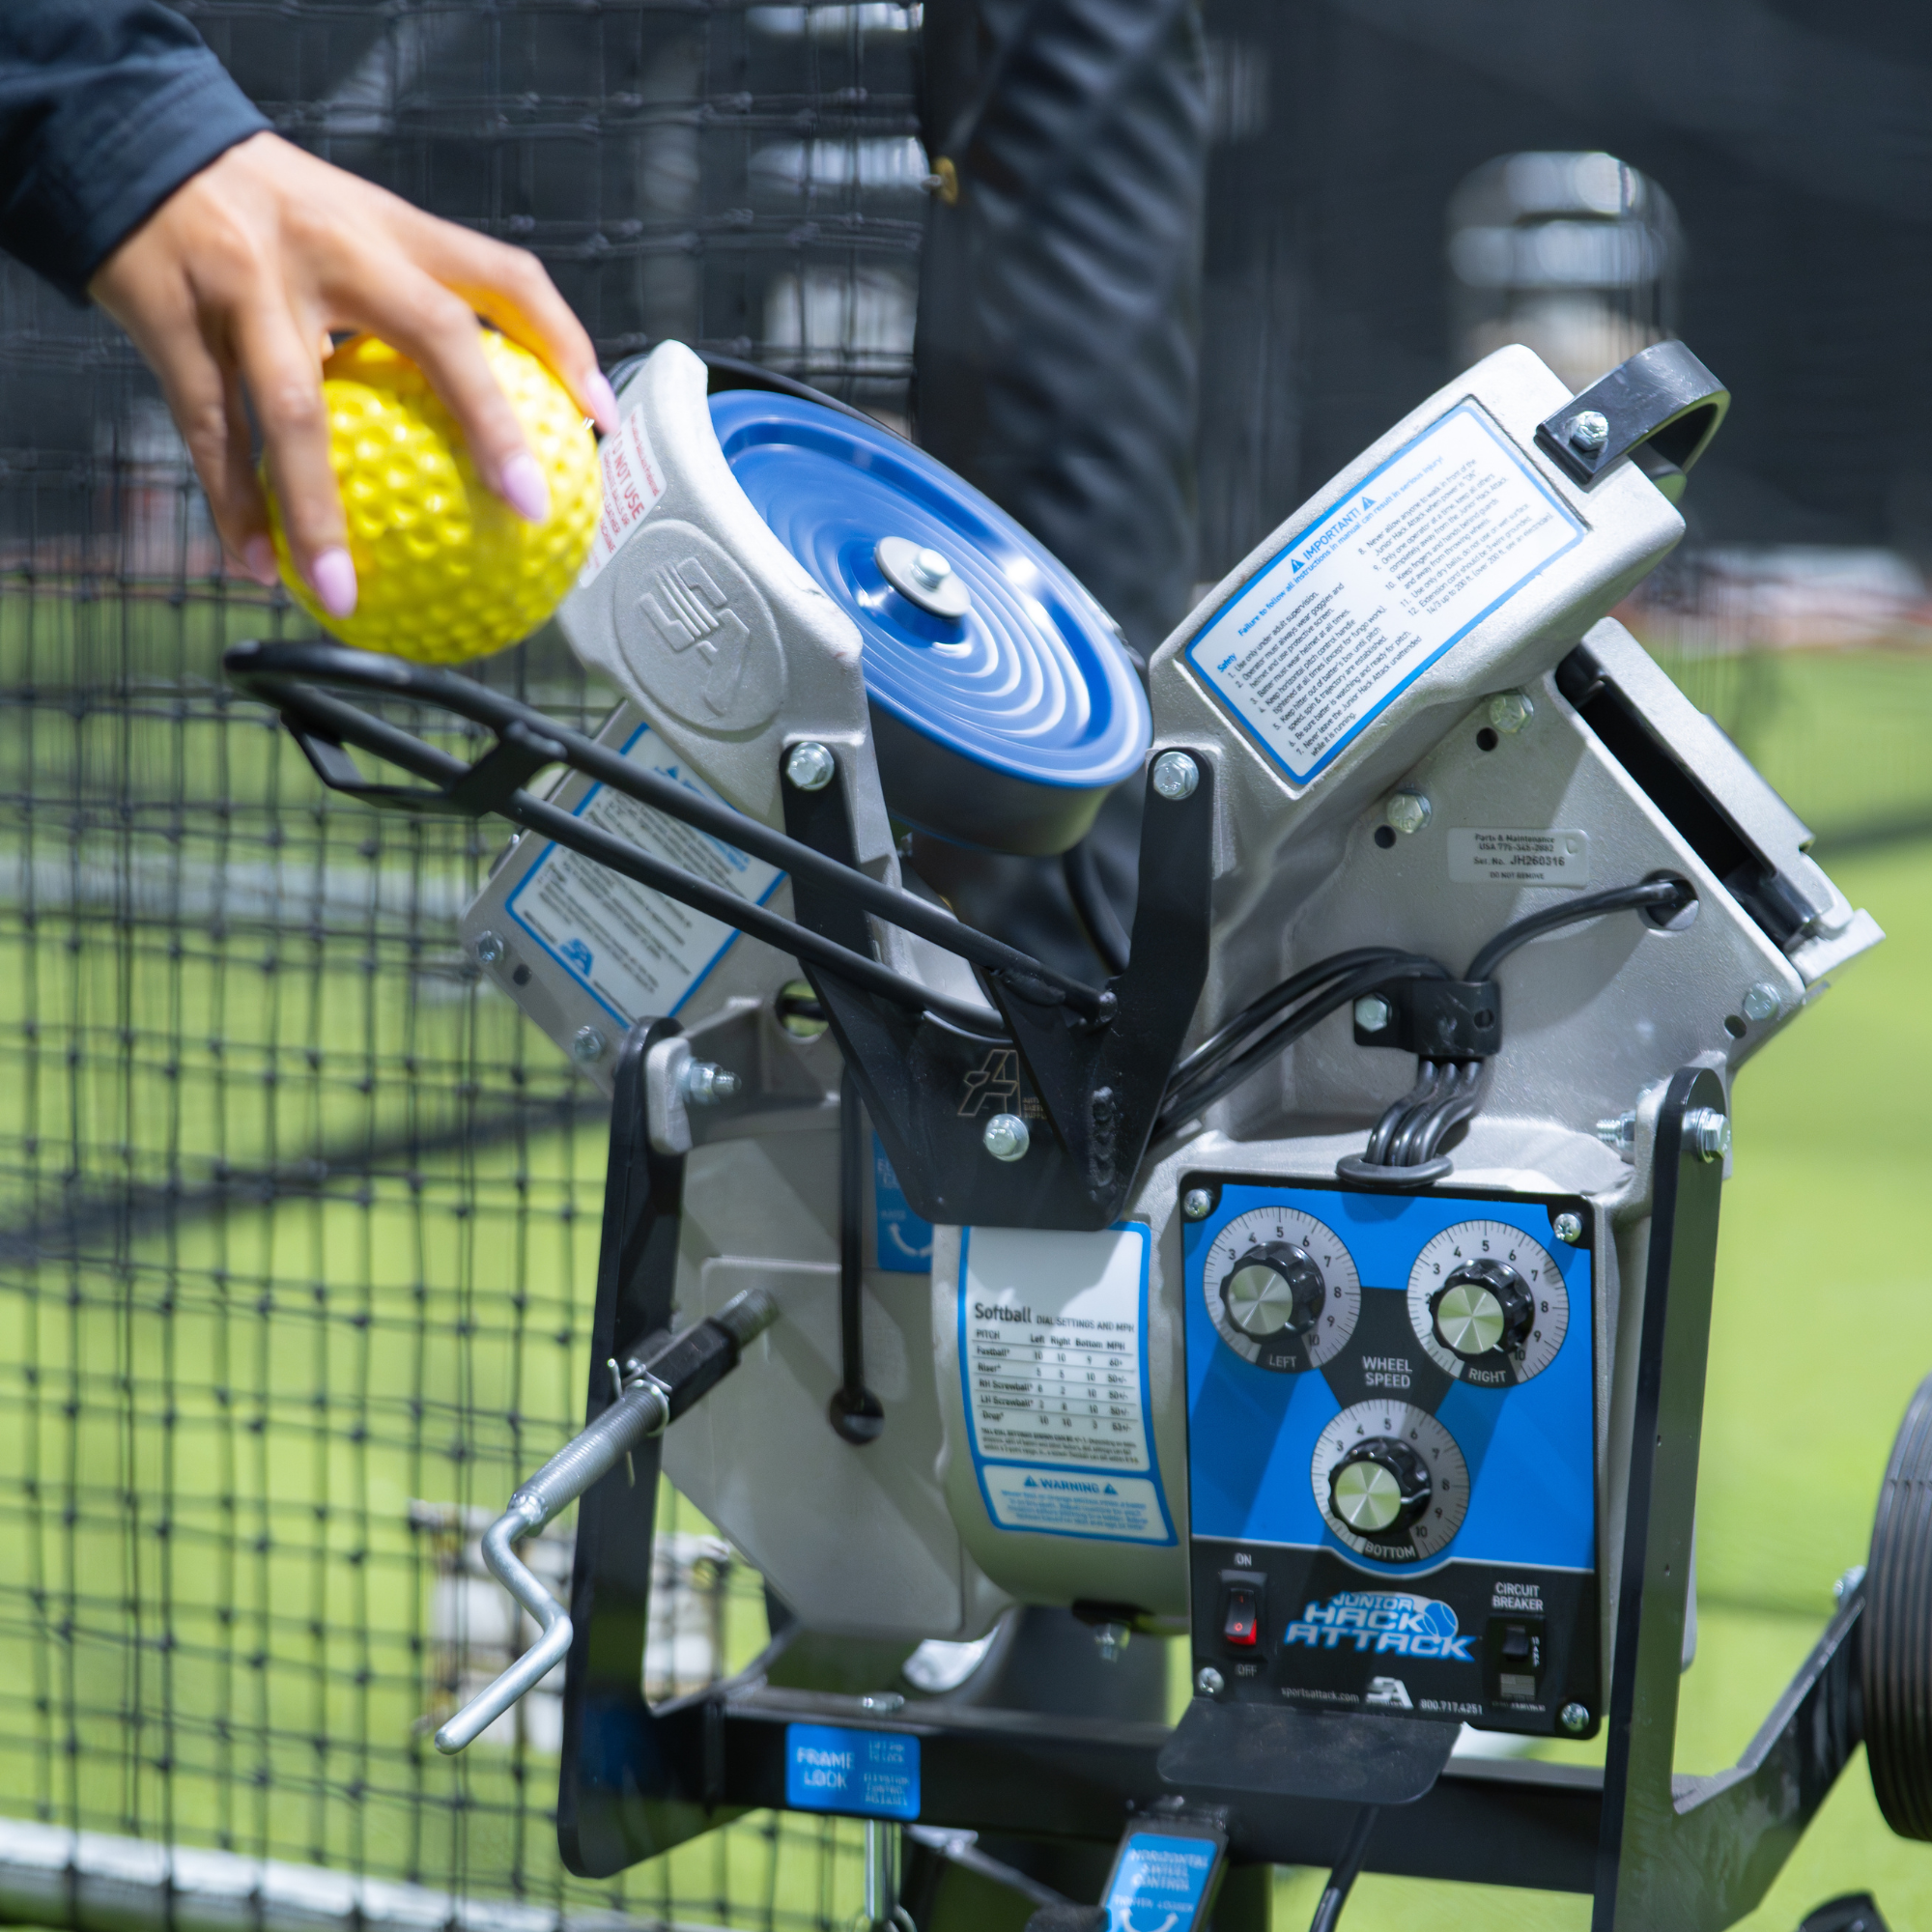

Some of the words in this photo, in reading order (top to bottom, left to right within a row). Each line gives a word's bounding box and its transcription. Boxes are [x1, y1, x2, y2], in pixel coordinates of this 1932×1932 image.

[614, 456, 632, 485] NOT
[624, 483, 645, 520] USE
[1303, 508, 1358, 560] IMPORTANT!
[1238, 615, 1259, 636] Failure
[1265, 591, 1286, 609] follow
[1286, 582, 1294, 591] all
[1293, 551, 1330, 583] instructions
[1338, 522, 1361, 544] manual
[1362, 513, 1374, 524] can
[1374, 497, 1393, 513] result
[1400, 473, 1422, 492] serious
[1422, 456, 1443, 473] injury!
[1235, 661, 1246, 671] Use
[1245, 649, 1258, 662] only
[1257, 634, 1271, 650] under
[1272, 620, 1287, 636] adult
[1286, 592, 1319, 622] supervision.
[1242, 657, 1264, 681] Operator
[1264, 644, 1279, 659] must
[1278, 627, 1297, 646] always
[1296, 613, 1310, 628] wear
[1311, 594, 1333, 616] goggles
[1332, 582, 1344, 595] and
[1249, 669, 1268, 689] helmet
[1267, 659, 1279, 671] and
[1278, 651, 1288, 661] use
[1287, 626, 1314, 653] protective
[1314, 609, 1333, 627] screen.
[1257, 680, 1273, 697] Batter
[1273, 667, 1288, 682] must
[1287, 654, 1300, 668] wear
[1299, 637, 1320, 656] helmet
[1332, 610, 1350, 625] times.
[1217, 655, 1236, 672] Safety
[1264, 692, 1280, 706] Keep
[1278, 667, 1304, 694] horizontal
[1304, 655, 1319, 669] pitch
[1317, 637, 1337, 656] control
[1335, 620, 1355, 638] handle
[1272, 689, 1297, 714] tightened
[1309, 663, 1324, 678] times
[1322, 644, 1345, 665] (except
[1343, 636, 1351, 645] for
[1350, 622, 1369, 638] fungo
[1280, 709, 1294, 724] Keep
[1293, 695, 1308, 710] hitter
[1308, 686, 1318, 696] out
[1321, 662, 1344, 682] batter's
[1342, 653, 1353, 663] box
[1353, 639, 1367, 652] until
[1366, 627, 1380, 642] pitch
[1507, 835, 1555, 843] Maintenance
[1511, 856, 1565, 866] JH260316
[1277, 1227, 1283, 1237] 5
[1303, 1236, 1310, 1247] 6
[1482, 1240, 1490, 1252] 5
[1229, 1249, 1236, 1260] 3
[1454, 1246, 1461, 1258] 4
[1509, 1250, 1517, 1261] 6
[1324, 1256, 1331, 1267] 7
[1434, 1264, 1440, 1274] 3
[1531, 1269, 1538, 1281] 7
[1334, 1287, 1341, 1298] 8
[1542, 1301, 1548, 1312] 8
[976, 1302, 1032, 1323] Softball
[1037, 1316, 1053, 1325] DIAL
[1057, 1318, 1094, 1329] SETTINGS
[1097, 1321, 1114, 1331] AND
[1117, 1322, 1134, 1332] MPH
[1327, 1316, 1335, 1327] 9
[977, 1329, 1000, 1340] PITCH
[1031, 1334, 1045, 1345] Left
[1051, 1335, 1070, 1347] Right
[1076, 1338, 1103, 1349] Bottom
[1107, 1341, 1125, 1350] MPH
[1309, 1335, 1320, 1346] 10
[1534, 1331, 1541, 1342] 9
[1269, 1354, 1296, 1368] LEFT
[1515, 1350, 1525, 1360] 10
[1362, 1356, 1412, 1373] WHEEL
[1366, 1373, 1410, 1387] SPEED
[1469, 1368, 1506, 1383] RIGHT
[1356, 1424, 1364, 1435] 4
[1385, 1418, 1392, 1430] 5
[1410, 1428, 1418, 1439] 6
[1039, 1478, 1099, 1493] WARNING
[1416, 1525, 1428, 1537] 10
[1364, 1540, 1416, 1557] BOTTOM
[1235, 1553, 1252, 1566] ON
[1496, 1582, 1540, 1597] CIRCUIT
[1332, 1592, 1413, 1612] JUNIOR
[1492, 1596, 1543, 1611] BREAKER
[1304, 1603, 1425, 1634] HACK
[1285, 1623, 1475, 1661] ATTACK
[1236, 1663, 1256, 1677] OFF
[1281, 1687, 1359, 1704] sportsattack.com
[1420, 1698, 1483, 1715] 800.717.4251
[796, 1747, 854, 1770] FRAME
